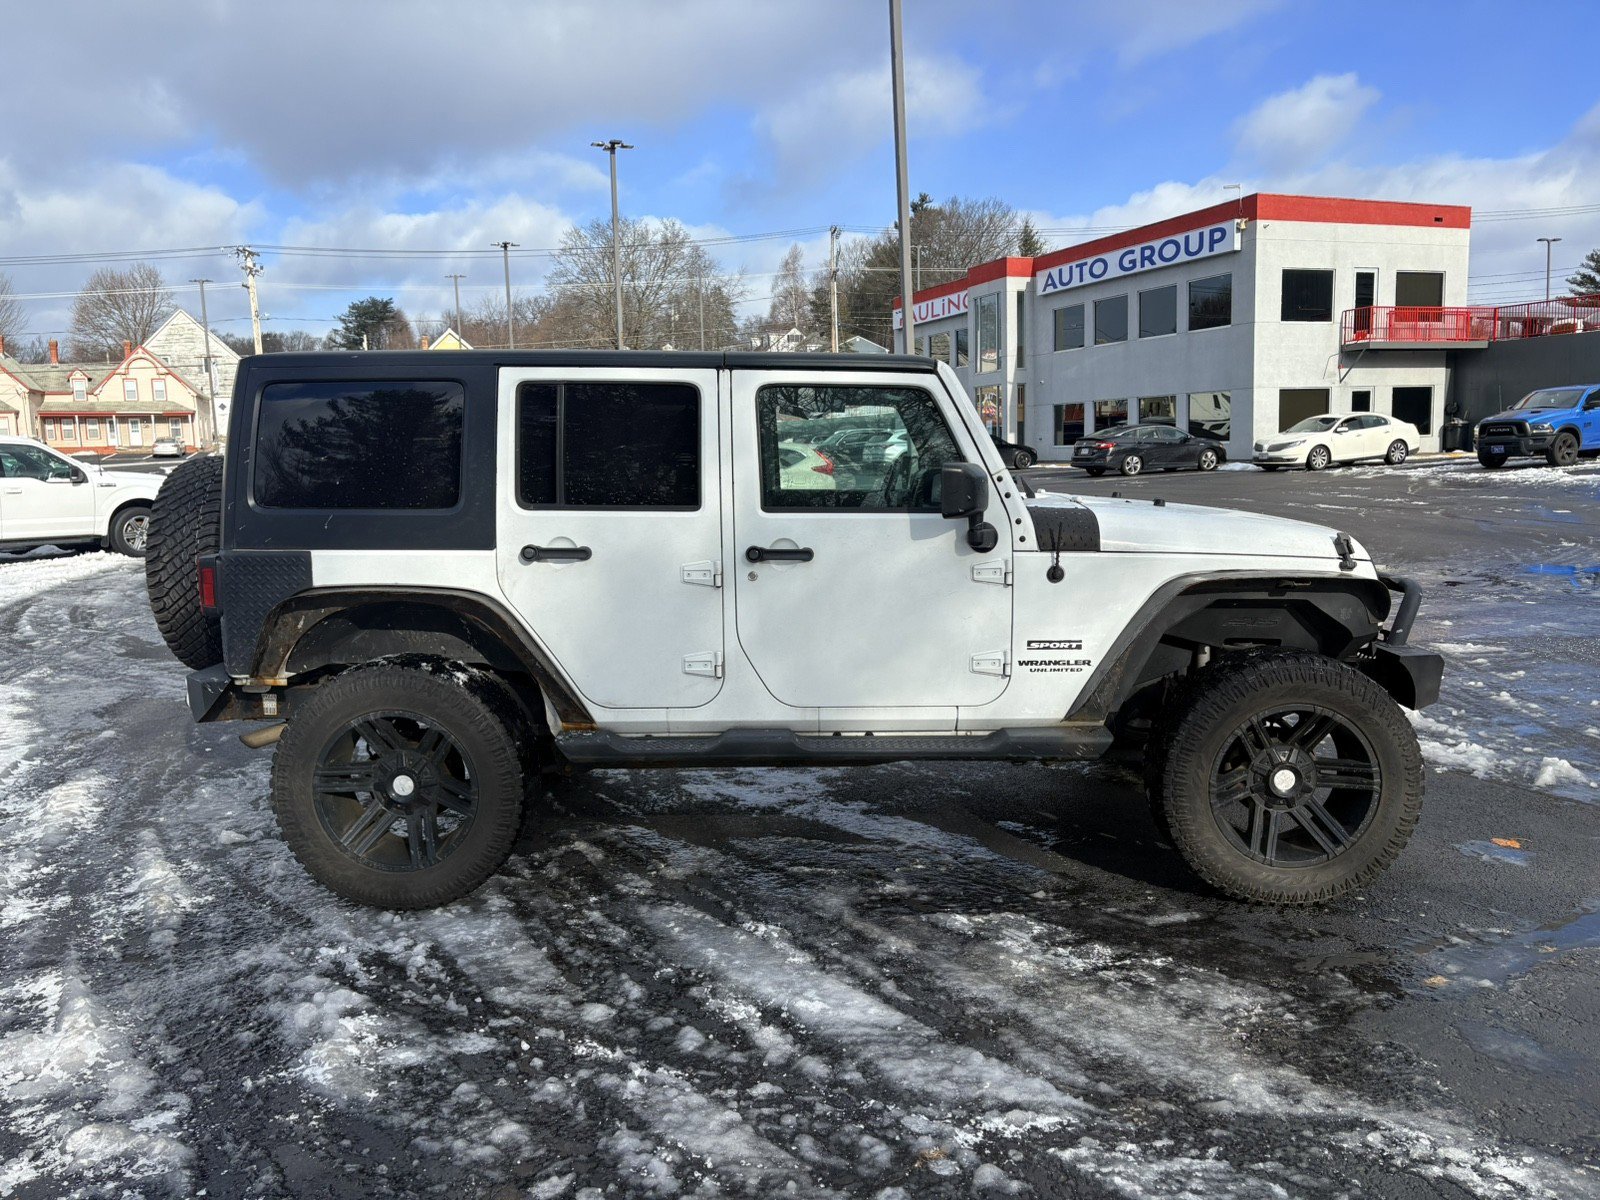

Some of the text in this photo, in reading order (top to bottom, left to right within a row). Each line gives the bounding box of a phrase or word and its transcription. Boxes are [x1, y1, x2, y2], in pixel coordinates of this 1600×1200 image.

[1042, 227, 1227, 293] AUTO GROUP
[1027, 641, 1082, 650] SPORT
